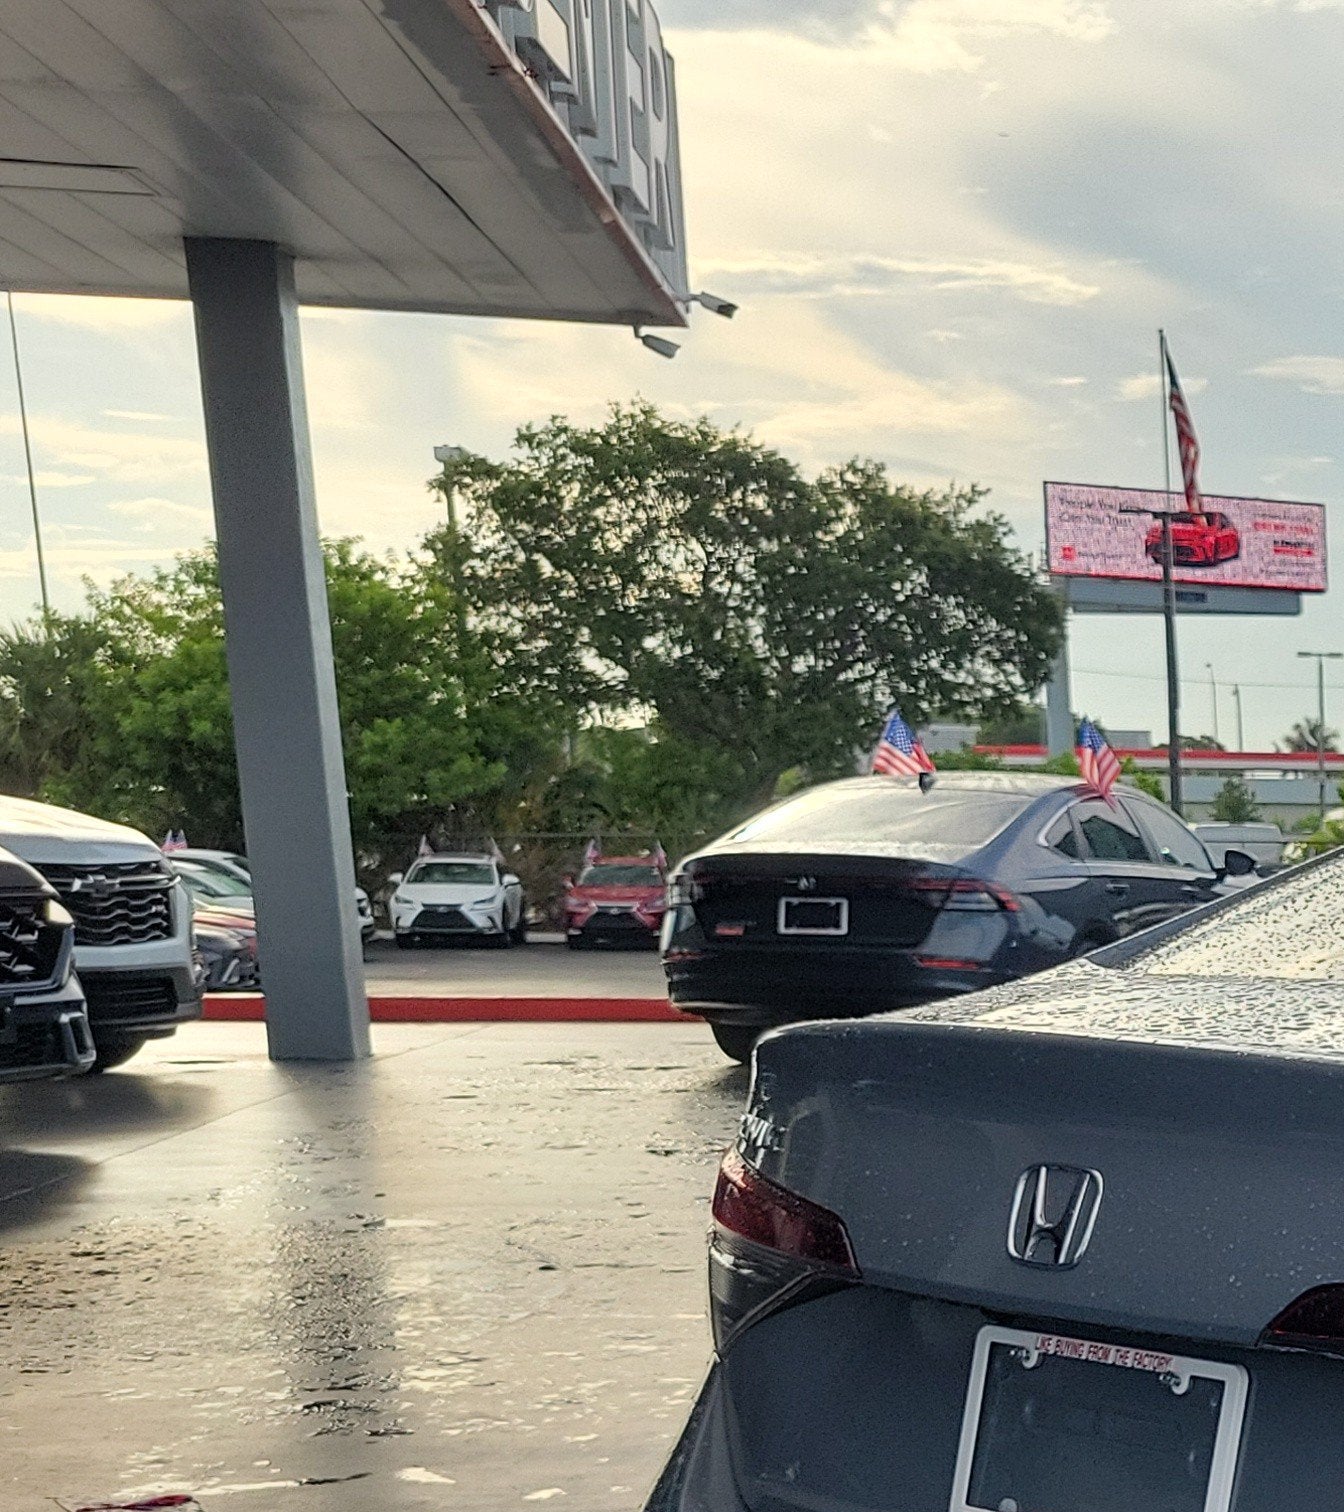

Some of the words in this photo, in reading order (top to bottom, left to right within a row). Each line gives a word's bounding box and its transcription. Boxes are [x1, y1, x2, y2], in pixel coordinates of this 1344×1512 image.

[1036, 1336, 1053, 1353] LIKE
[1055, 1339, 1085, 1358] BUYING
[1088, 1344, 1112, 1362] FROM
[1115, 1349, 1131, 1366] THE
[1133, 1351, 1174, 1370] FACTORY
